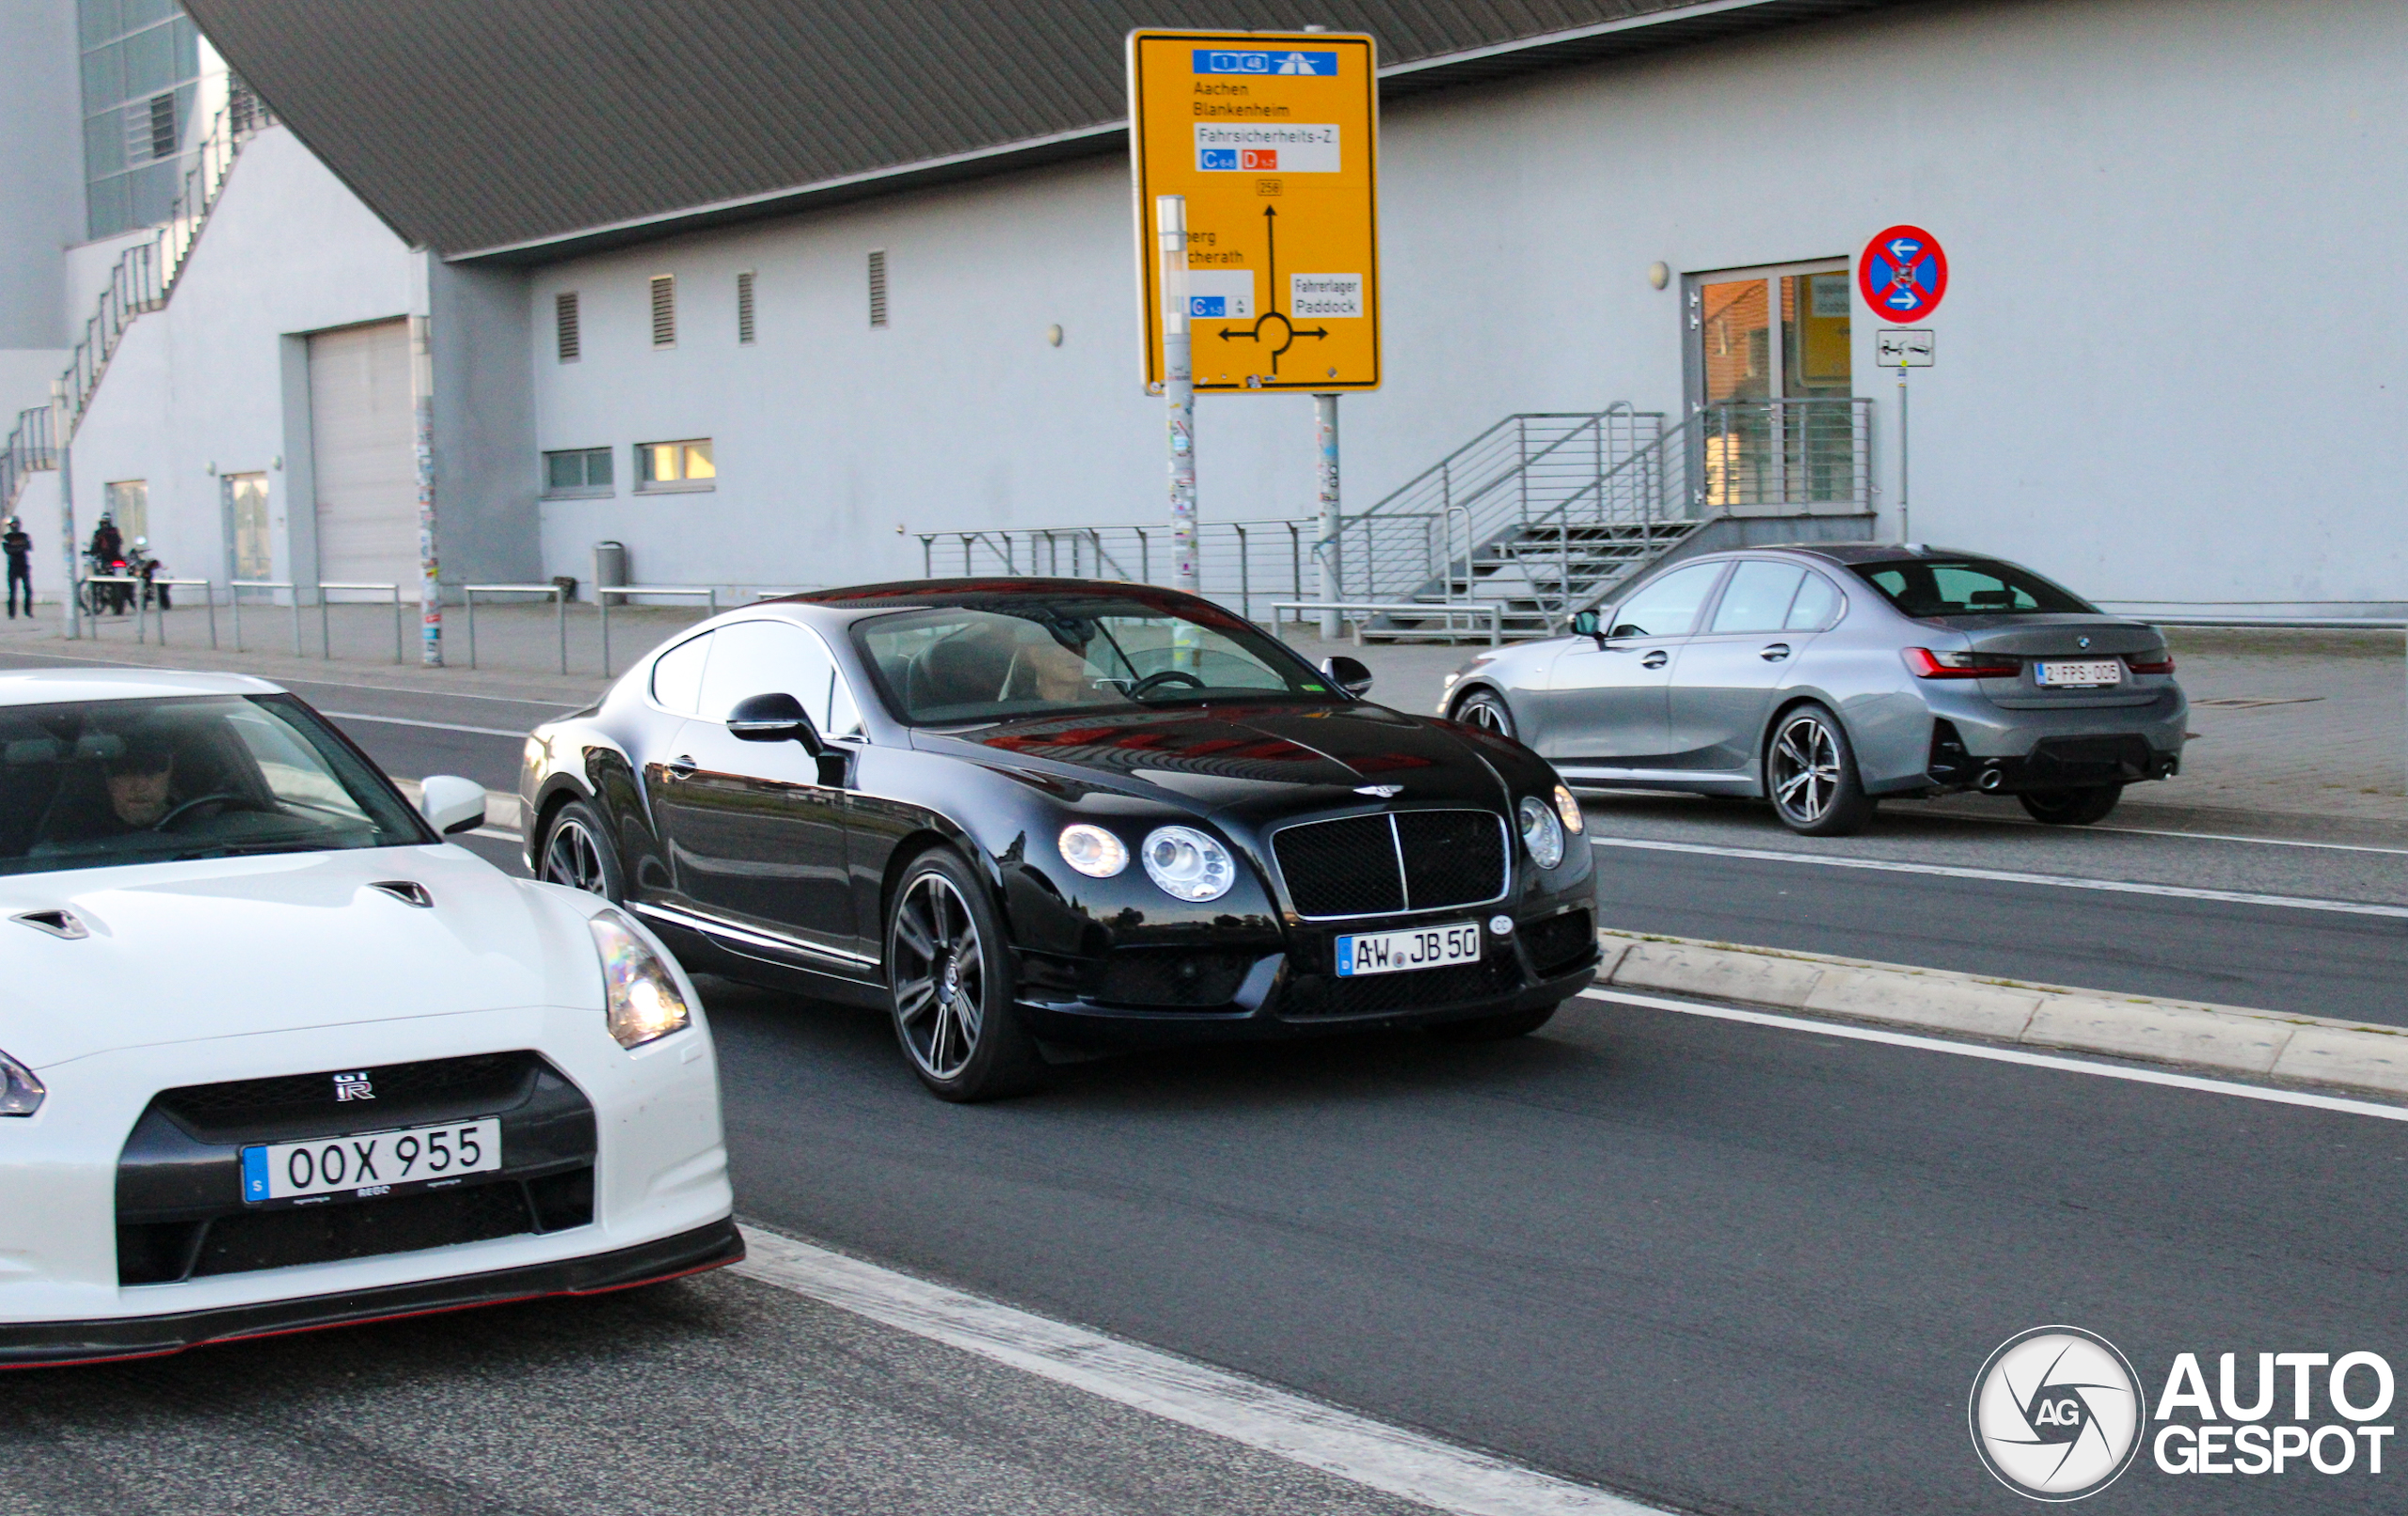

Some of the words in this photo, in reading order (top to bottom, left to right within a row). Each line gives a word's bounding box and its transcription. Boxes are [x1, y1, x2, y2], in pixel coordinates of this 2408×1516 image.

[1195, 82, 1249, 96] Aachen
[1194, 103, 1290, 117] Blankenheim
[1188, 250, 1244, 263] cherath
[1295, 279, 1357, 295] Fahrerlager
[1296, 300, 1357, 313] Paddock
[1356, 939, 1389, 970] AW
[1411, 932, 1441, 963] JB
[1448, 927, 1477, 957] 50
[395, 1127, 481, 1176] 955
[252, 1179, 263, 1192] S
